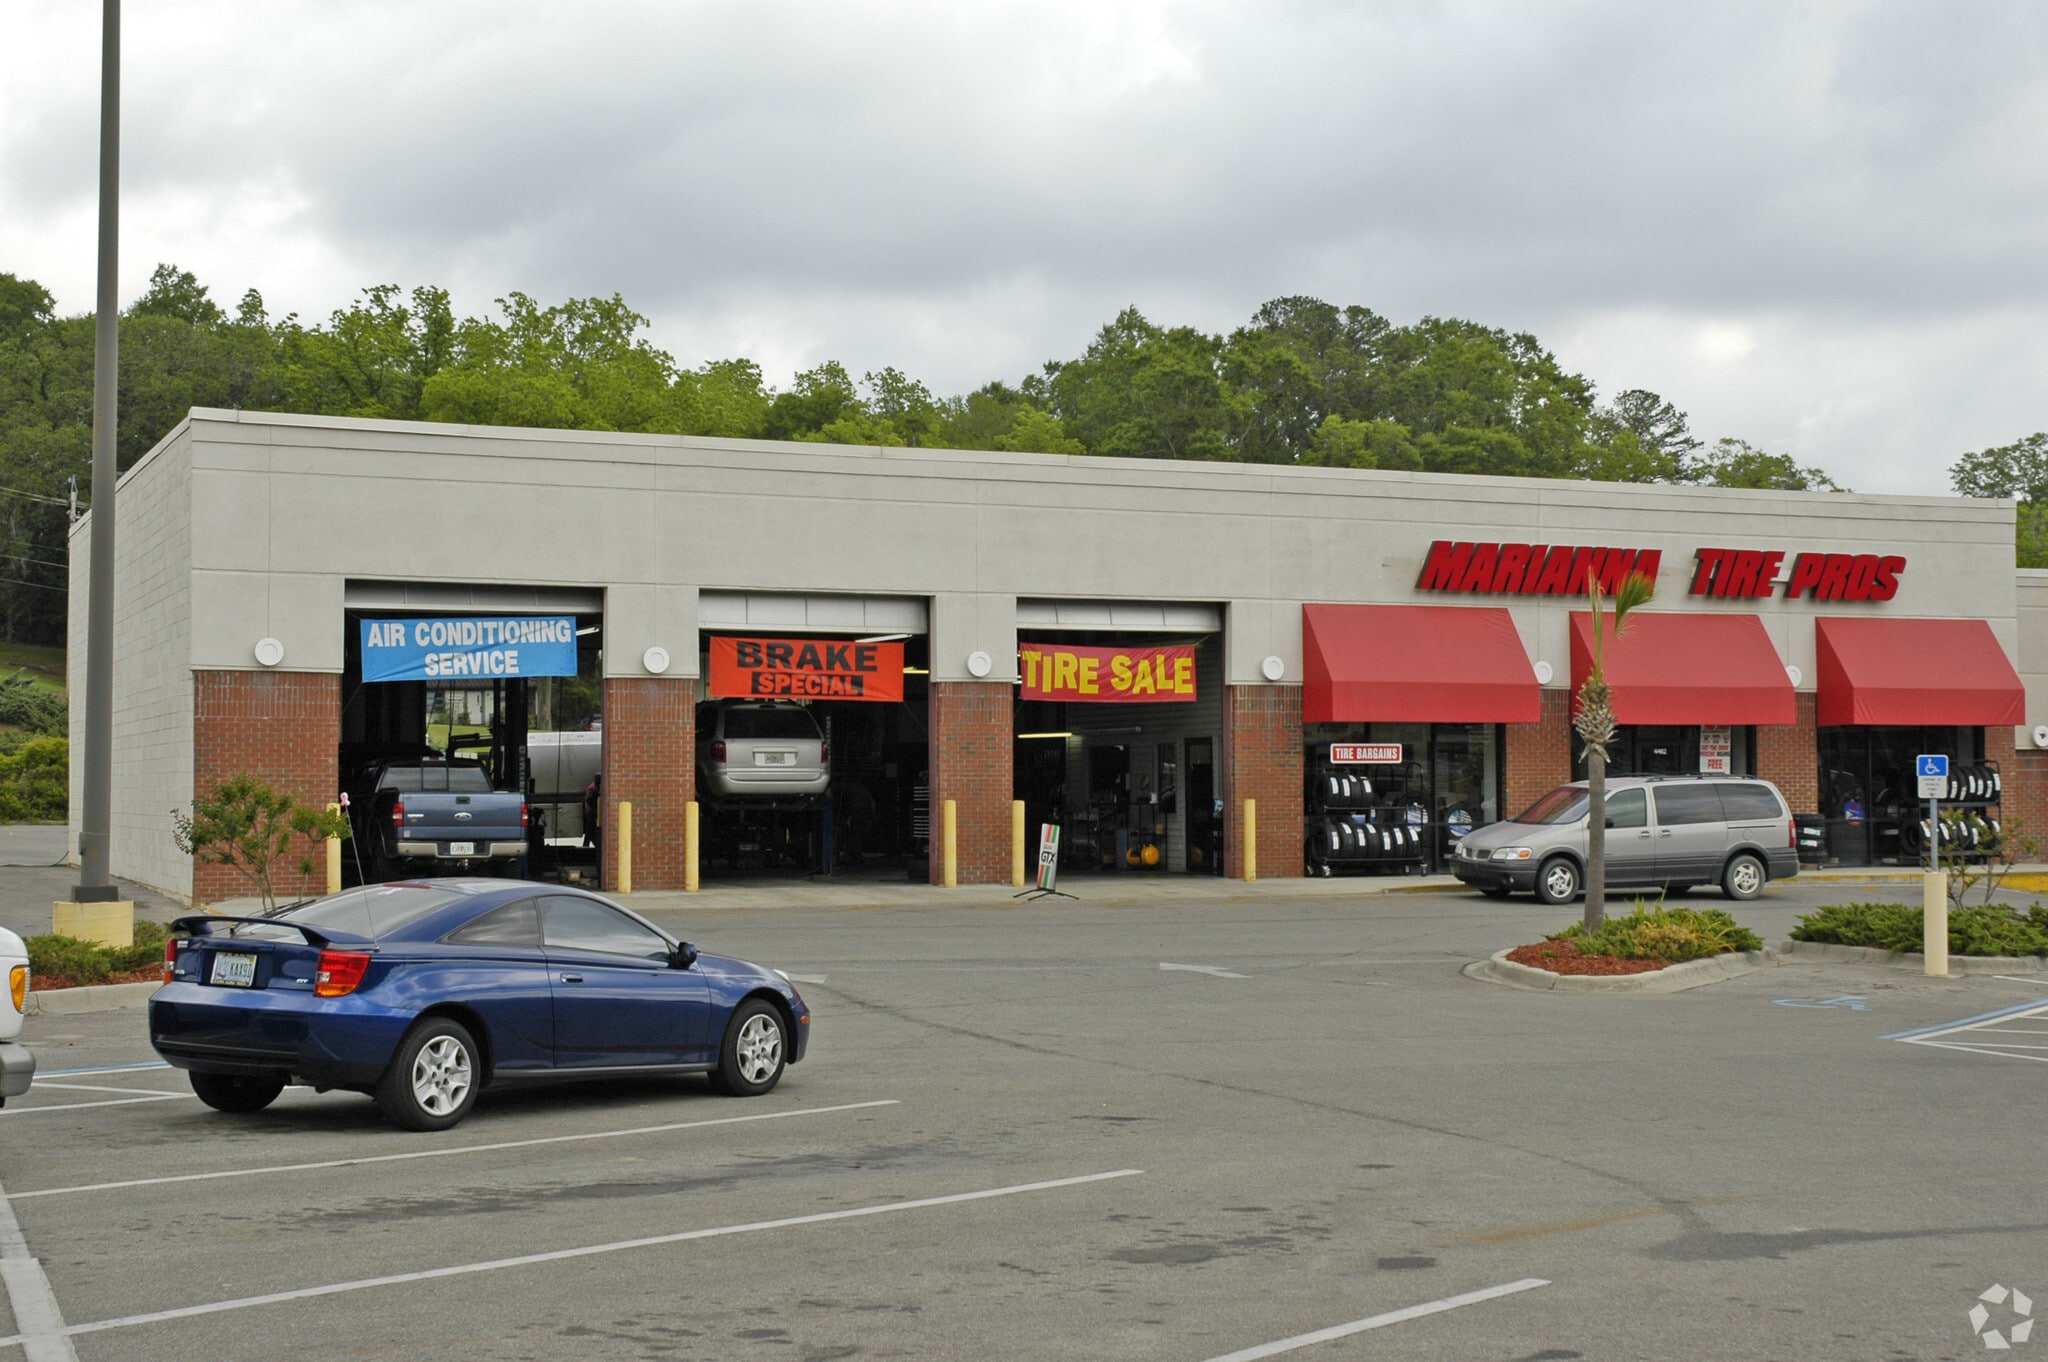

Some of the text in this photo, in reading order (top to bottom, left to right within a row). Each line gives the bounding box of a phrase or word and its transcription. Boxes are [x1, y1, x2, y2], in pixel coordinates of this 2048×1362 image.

[1416, 540, 1907, 601] MARIANNA TIRE PROS
[367, 620, 572, 647] AIR CONDITIONING
[424, 650, 520, 676] SERVICE
[737, 641, 877, 671] BRAKE
[758, 673, 859, 695] SPECIAL
[1022, 650, 1193, 695] TIRE SALE
[1335, 747, 1398, 760] TIRE BARGAINS
[1041, 851, 1056, 864] GTX
